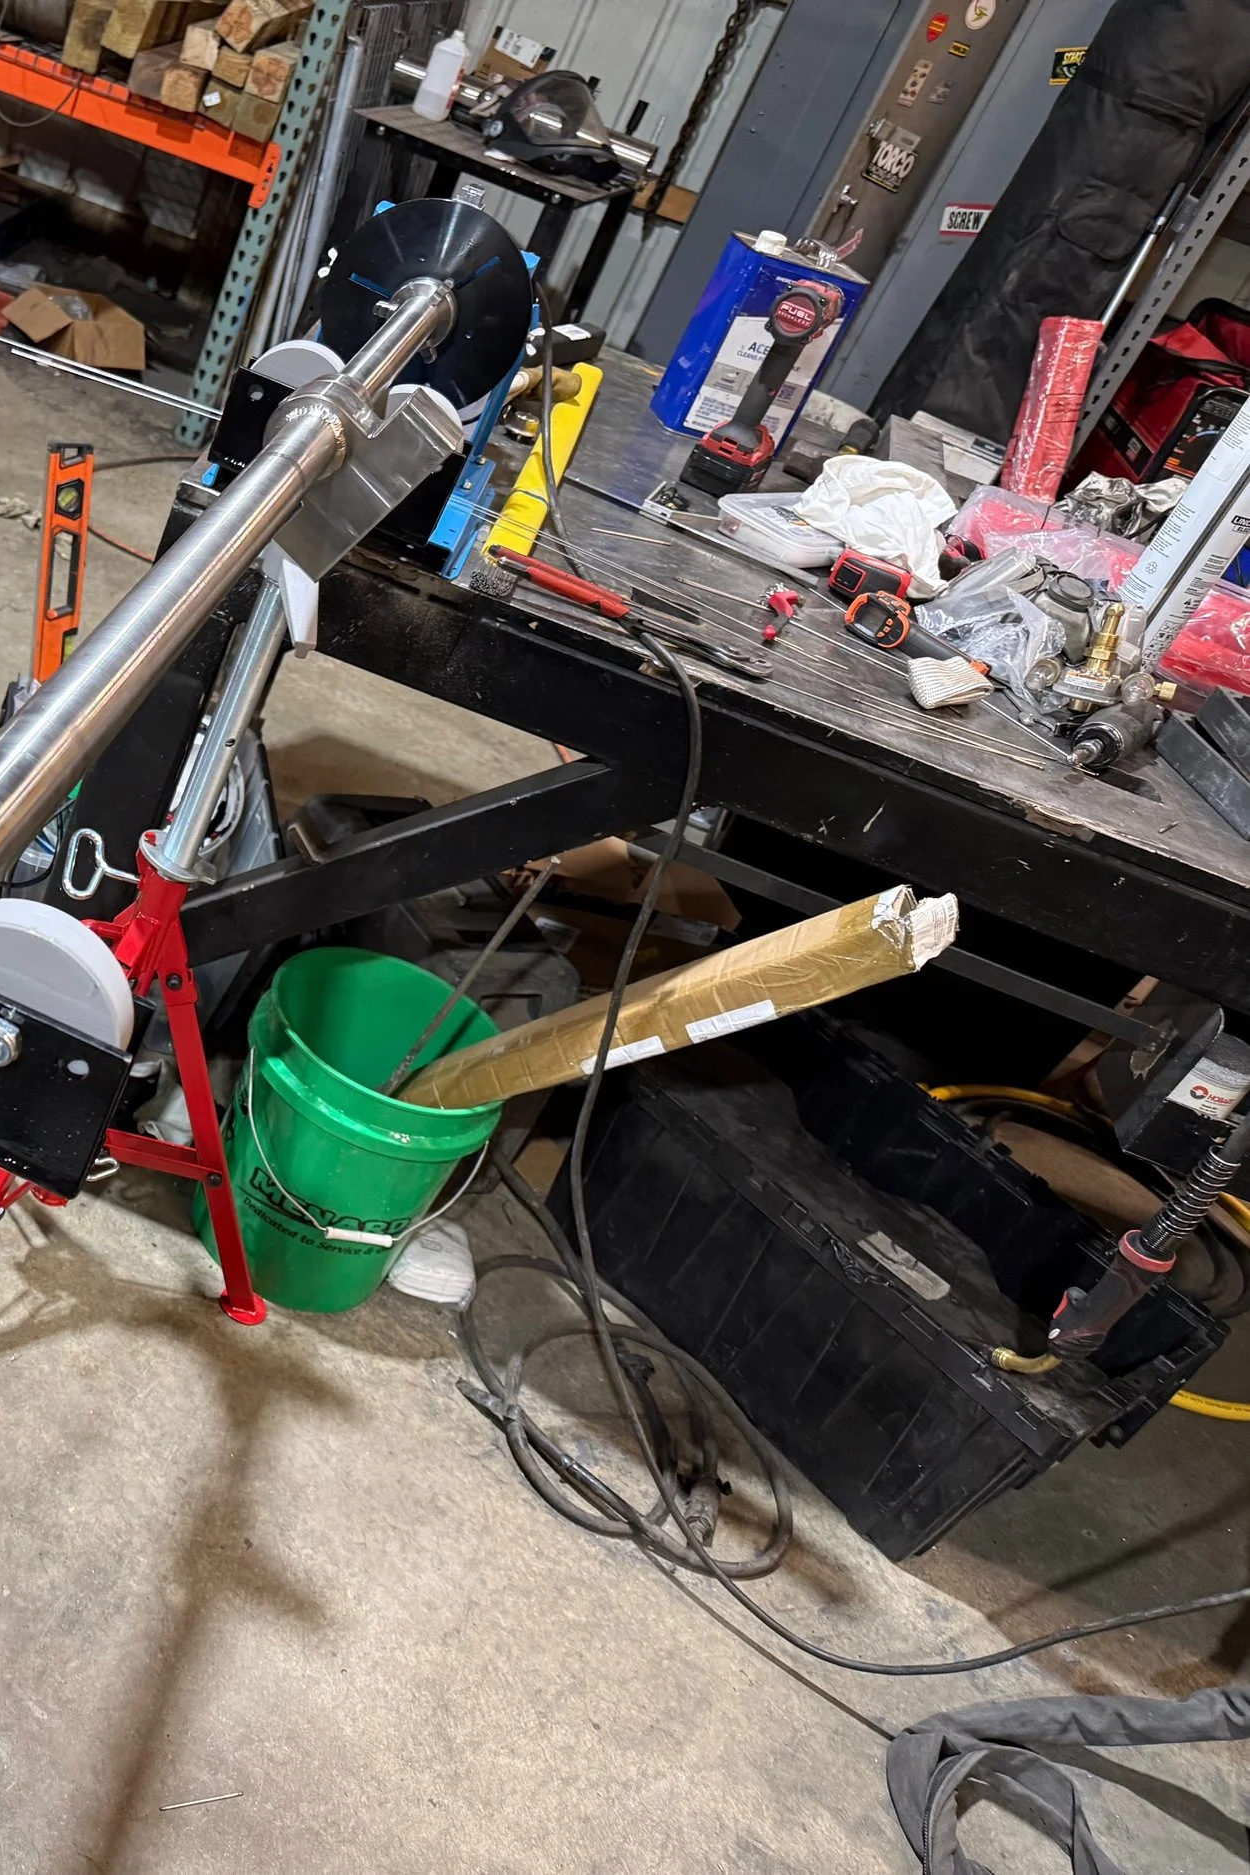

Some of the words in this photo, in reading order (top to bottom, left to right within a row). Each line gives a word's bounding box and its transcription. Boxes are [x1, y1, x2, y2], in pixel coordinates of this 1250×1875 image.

[872, 140, 916, 179] TORCO
[947, 211, 984, 230] SCREW
[780, 303, 813, 322] FUEL
[243, 1197, 298, 1239] Dedicated
[301, 1235, 315, 1246] to
